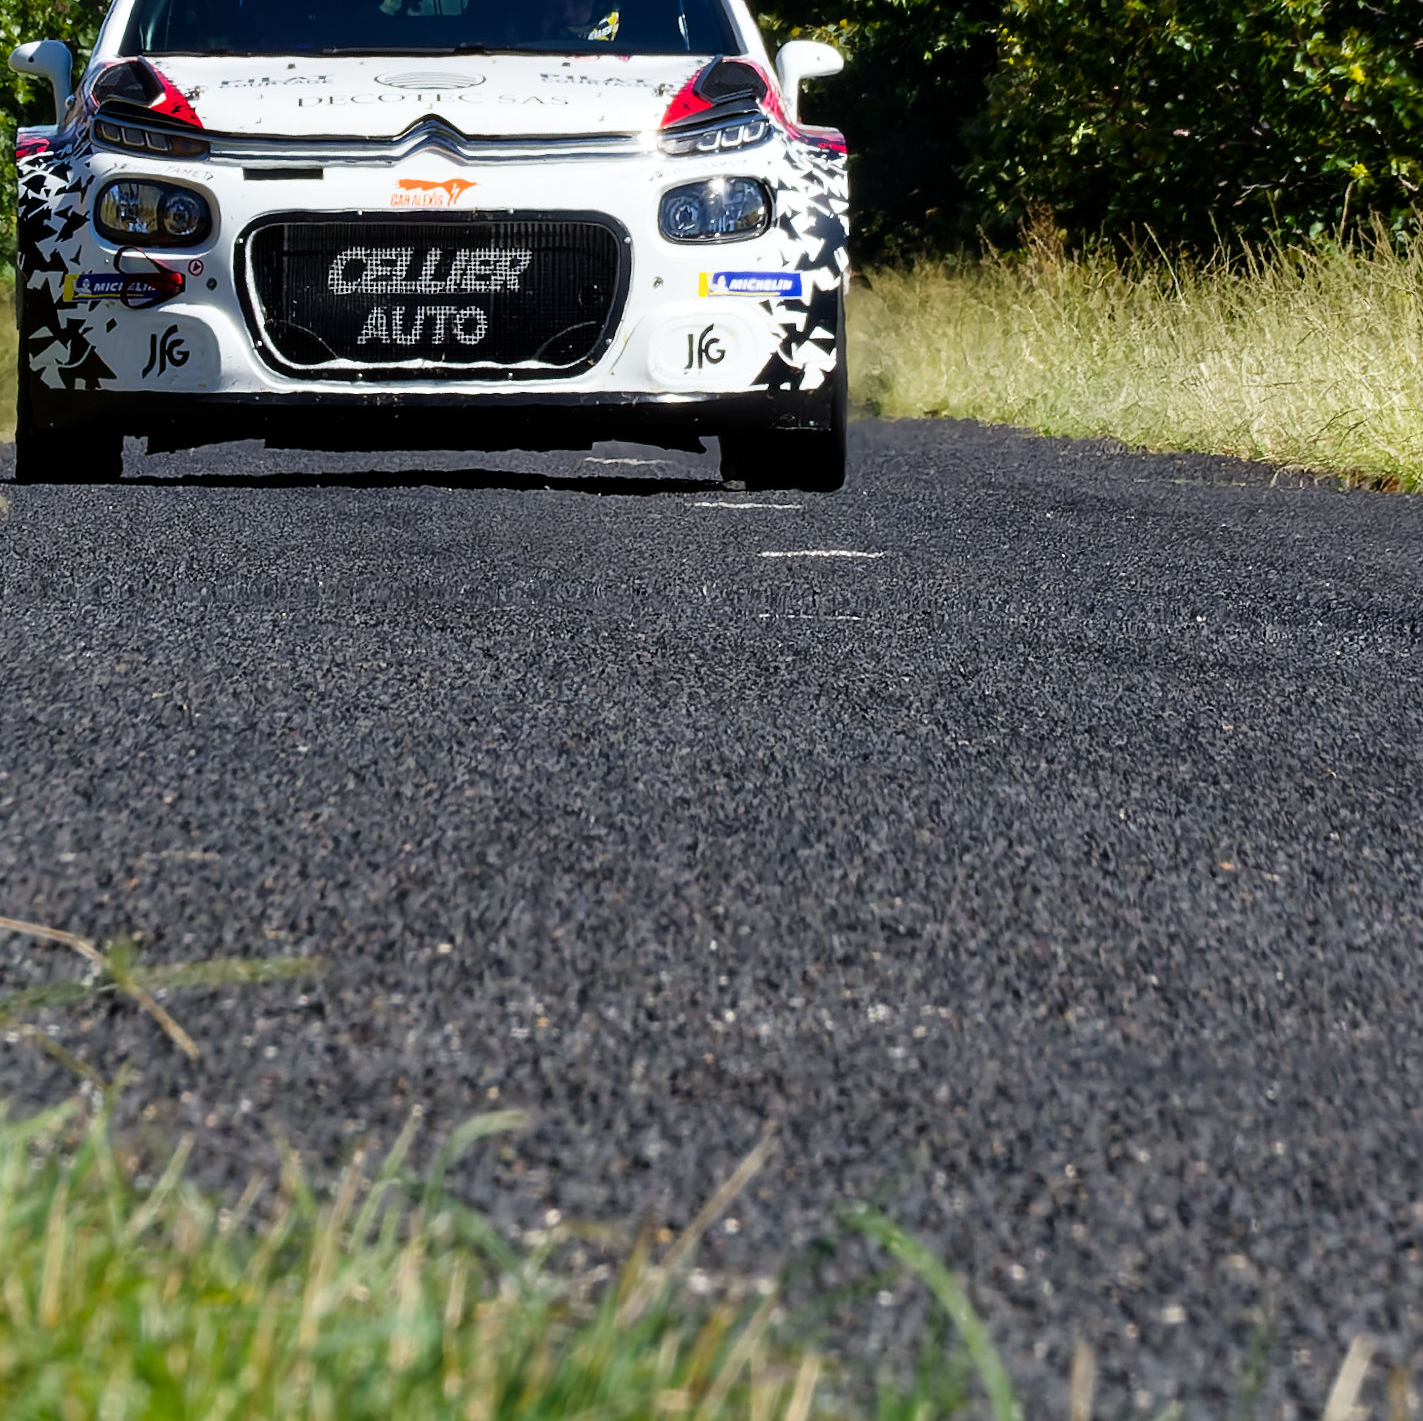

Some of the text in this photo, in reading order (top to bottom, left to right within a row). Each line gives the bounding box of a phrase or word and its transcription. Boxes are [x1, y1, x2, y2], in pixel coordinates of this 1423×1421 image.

[297, 92, 569, 107] DECOTEC SAS
[328, 247, 532, 295] CELLIER
[729, 278, 793, 291] MICHELIN
[357, 306, 487, 345] AUTO
